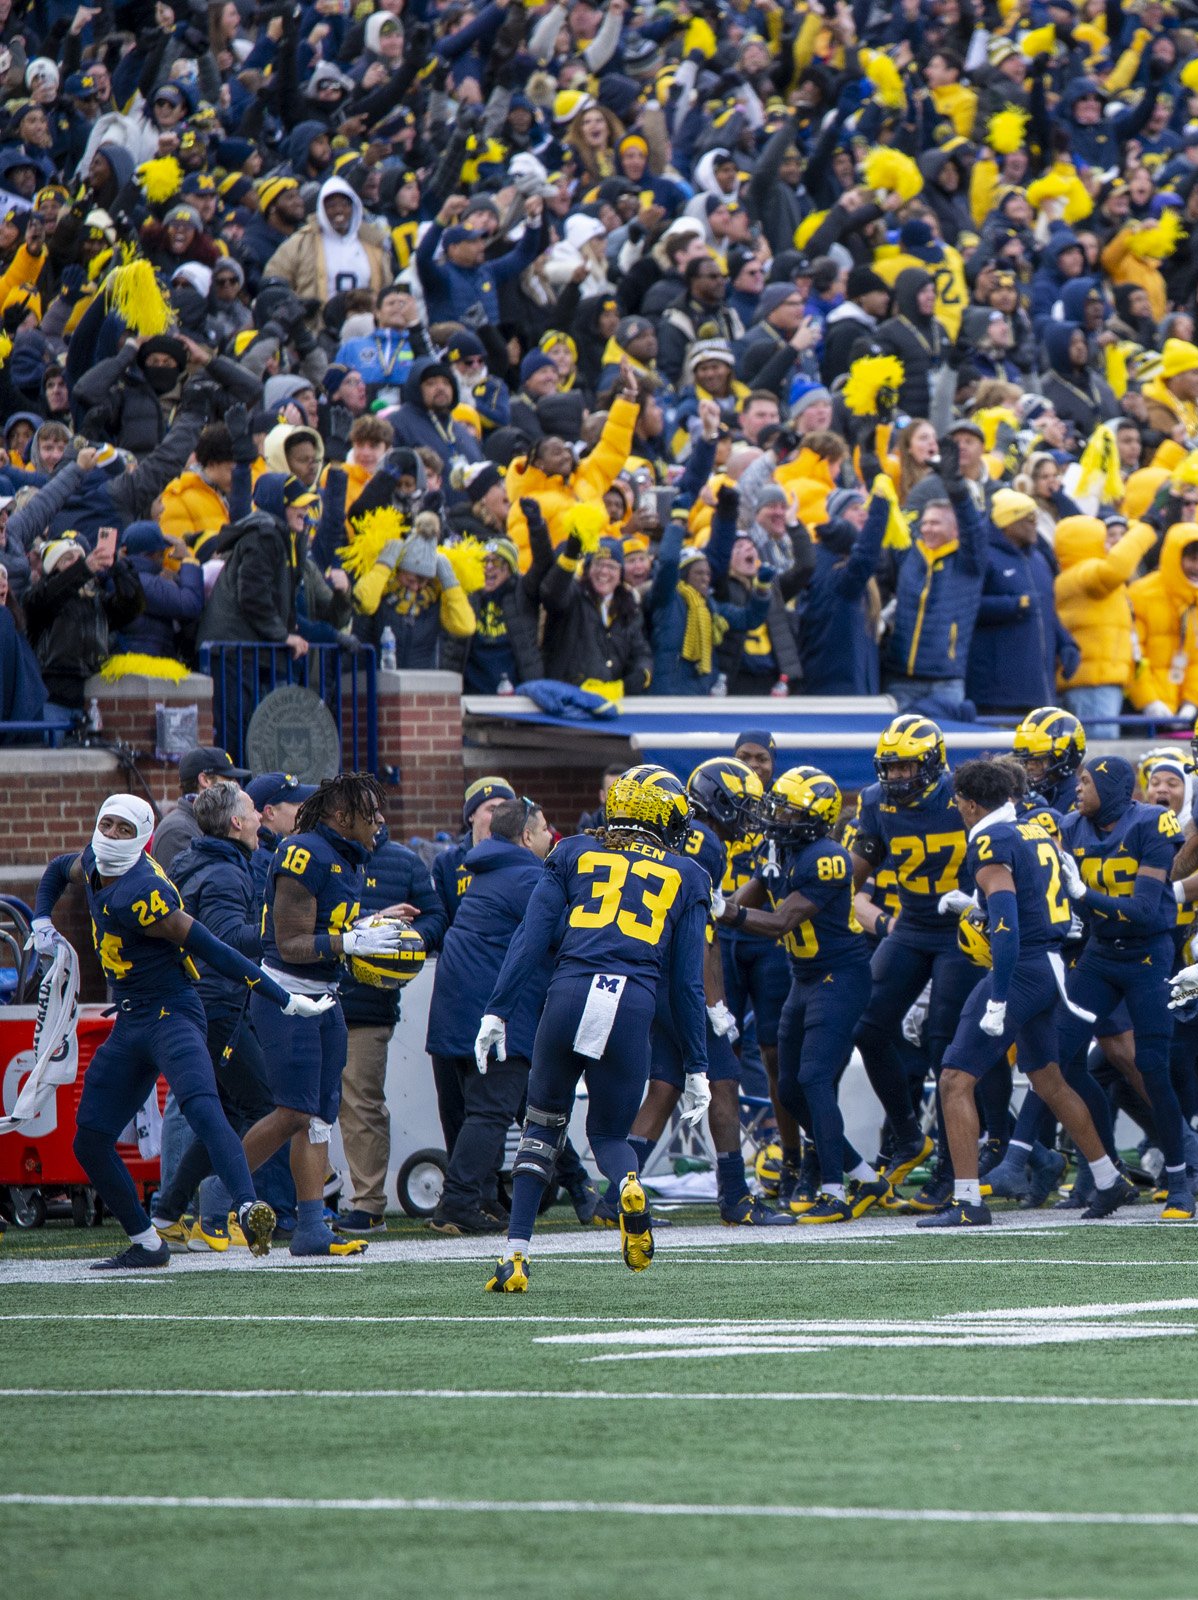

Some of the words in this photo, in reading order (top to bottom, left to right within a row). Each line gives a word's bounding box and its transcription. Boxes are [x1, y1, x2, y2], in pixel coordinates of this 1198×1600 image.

[1157, 809, 1182, 838] 46
[281, 844, 311, 875] 18
[608, 841, 666, 862] EEN
[889, 830, 968, 895] 27
[976, 835, 994, 861] 2
[816, 855, 847, 881] 80
[568, 850, 683, 946] 33
[1037, 843, 1072, 924] 2
[131, 889, 170, 927] 24
[595, 975, 620, 994] M
